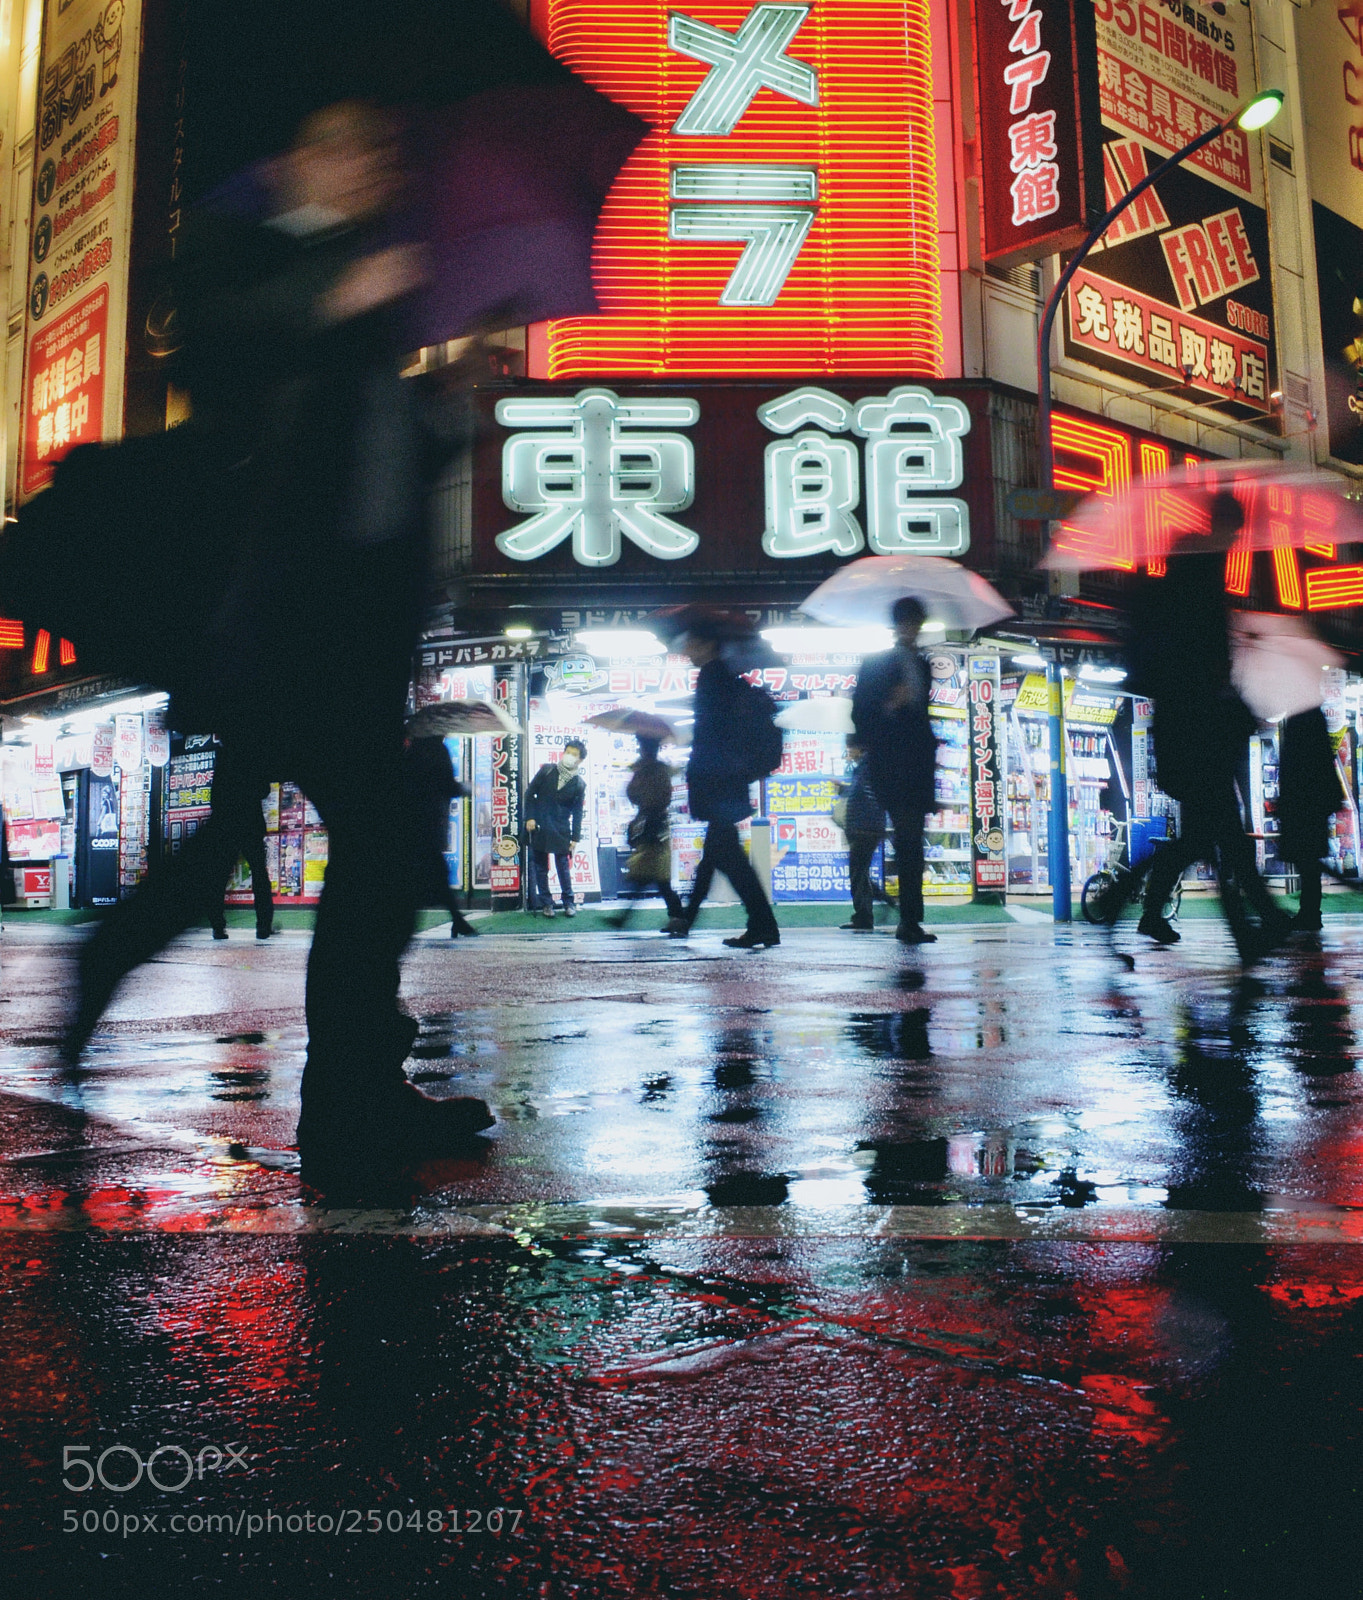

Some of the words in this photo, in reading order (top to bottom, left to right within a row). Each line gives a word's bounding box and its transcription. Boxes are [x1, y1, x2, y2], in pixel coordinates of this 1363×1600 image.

[1159, 207, 1260, 312] FREE
[1226, 299, 1270, 340] STORE
[32, 332, 101, 416] 新規会員
[1076, 283, 1265, 401] 免税品取扱店
[37, 392, 89, 460] 募集中
[494, 386, 971, 567] 東館
[422, 641, 540, 666] ヨドバシカメラ
[767, 780, 851, 797] ネットで注
[969, 679, 996, 834] 10%ポイント還元!
